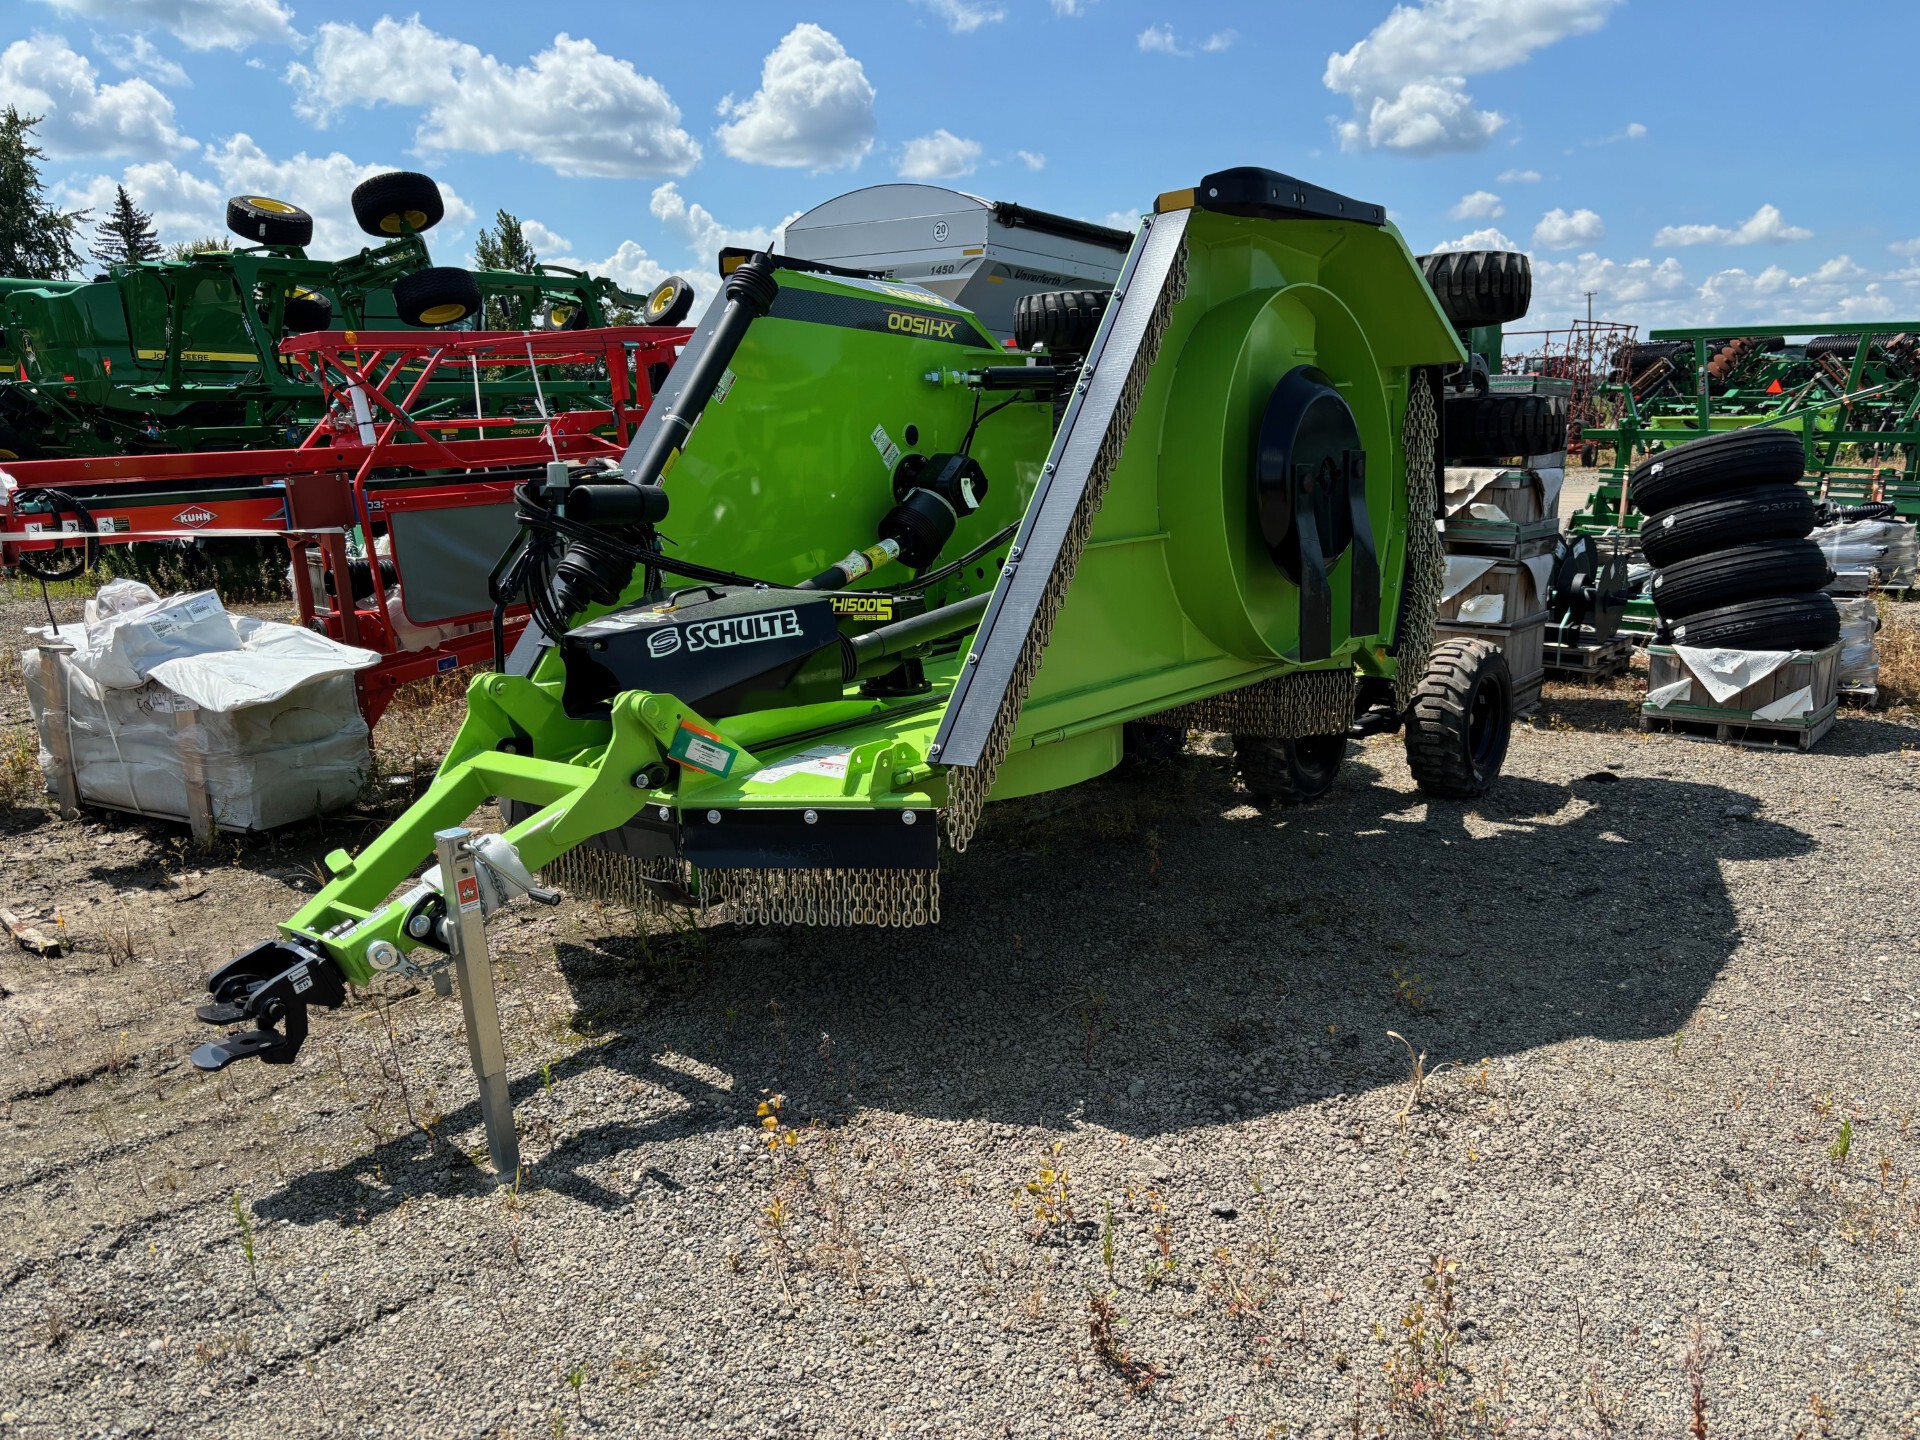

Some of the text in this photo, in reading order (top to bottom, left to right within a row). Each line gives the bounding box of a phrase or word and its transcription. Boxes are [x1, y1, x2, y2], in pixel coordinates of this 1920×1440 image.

[935, 224, 946, 235] 20
[931, 264, 955, 276] 1450
[1014, 269, 1062, 286] Unverferth
[887, 313, 957, 339] XH1500
[180, 353, 210, 361] DEERE
[180, 512, 212, 524] KUHN
[830, 598, 876, 612] H1500
[687, 610, 799, 652] SCHULTE
